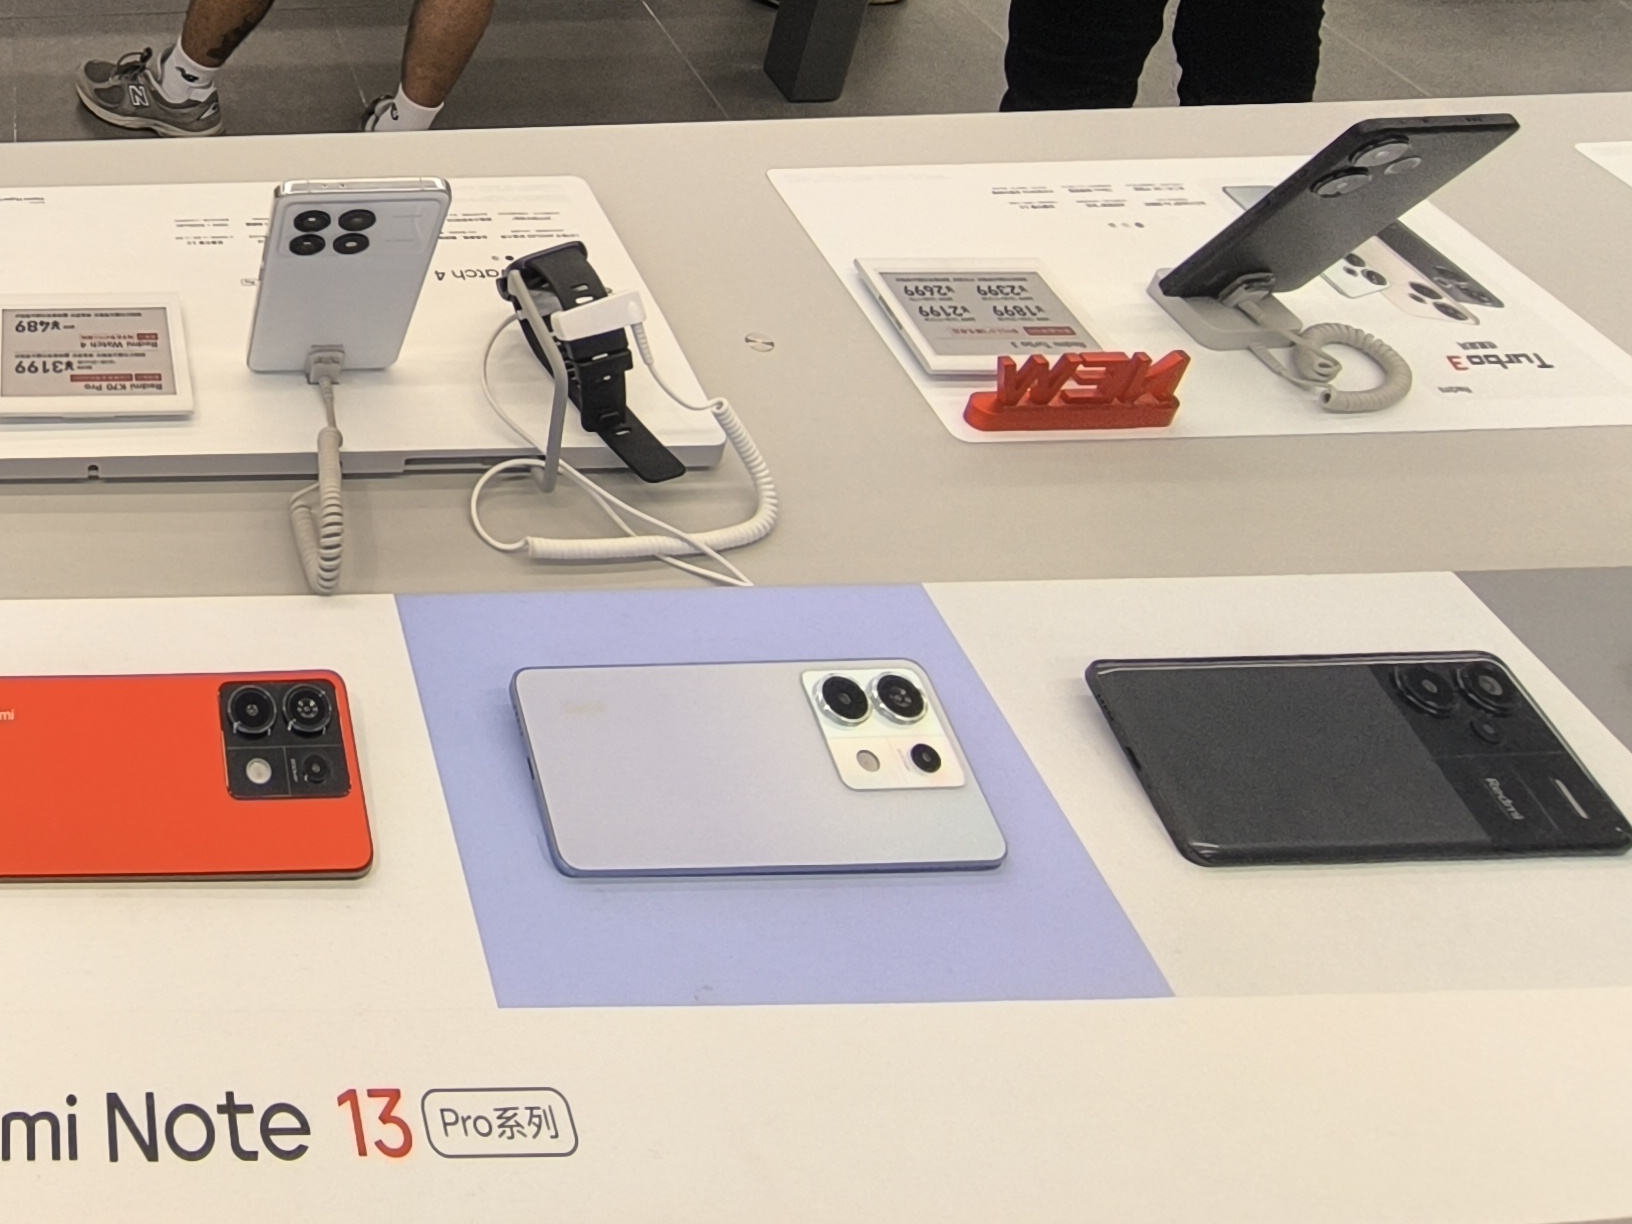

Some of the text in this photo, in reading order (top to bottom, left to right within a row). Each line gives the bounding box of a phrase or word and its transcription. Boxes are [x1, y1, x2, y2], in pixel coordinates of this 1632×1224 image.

[434, 268, 505, 281] atch 4
[14, 320, 61, 333] ¥489
[14, 360, 74, 374] ¥3199
[1446, 352, 1555, 371] Turbo 3
[84, 384, 102, 392] Pro
[1485, 777, 1525, 820] Redmi
[106, 1090, 312, 1163] Note
[336, 1088, 414, 1158] 13
[439, 1104, 560, 1143] Pro系列
